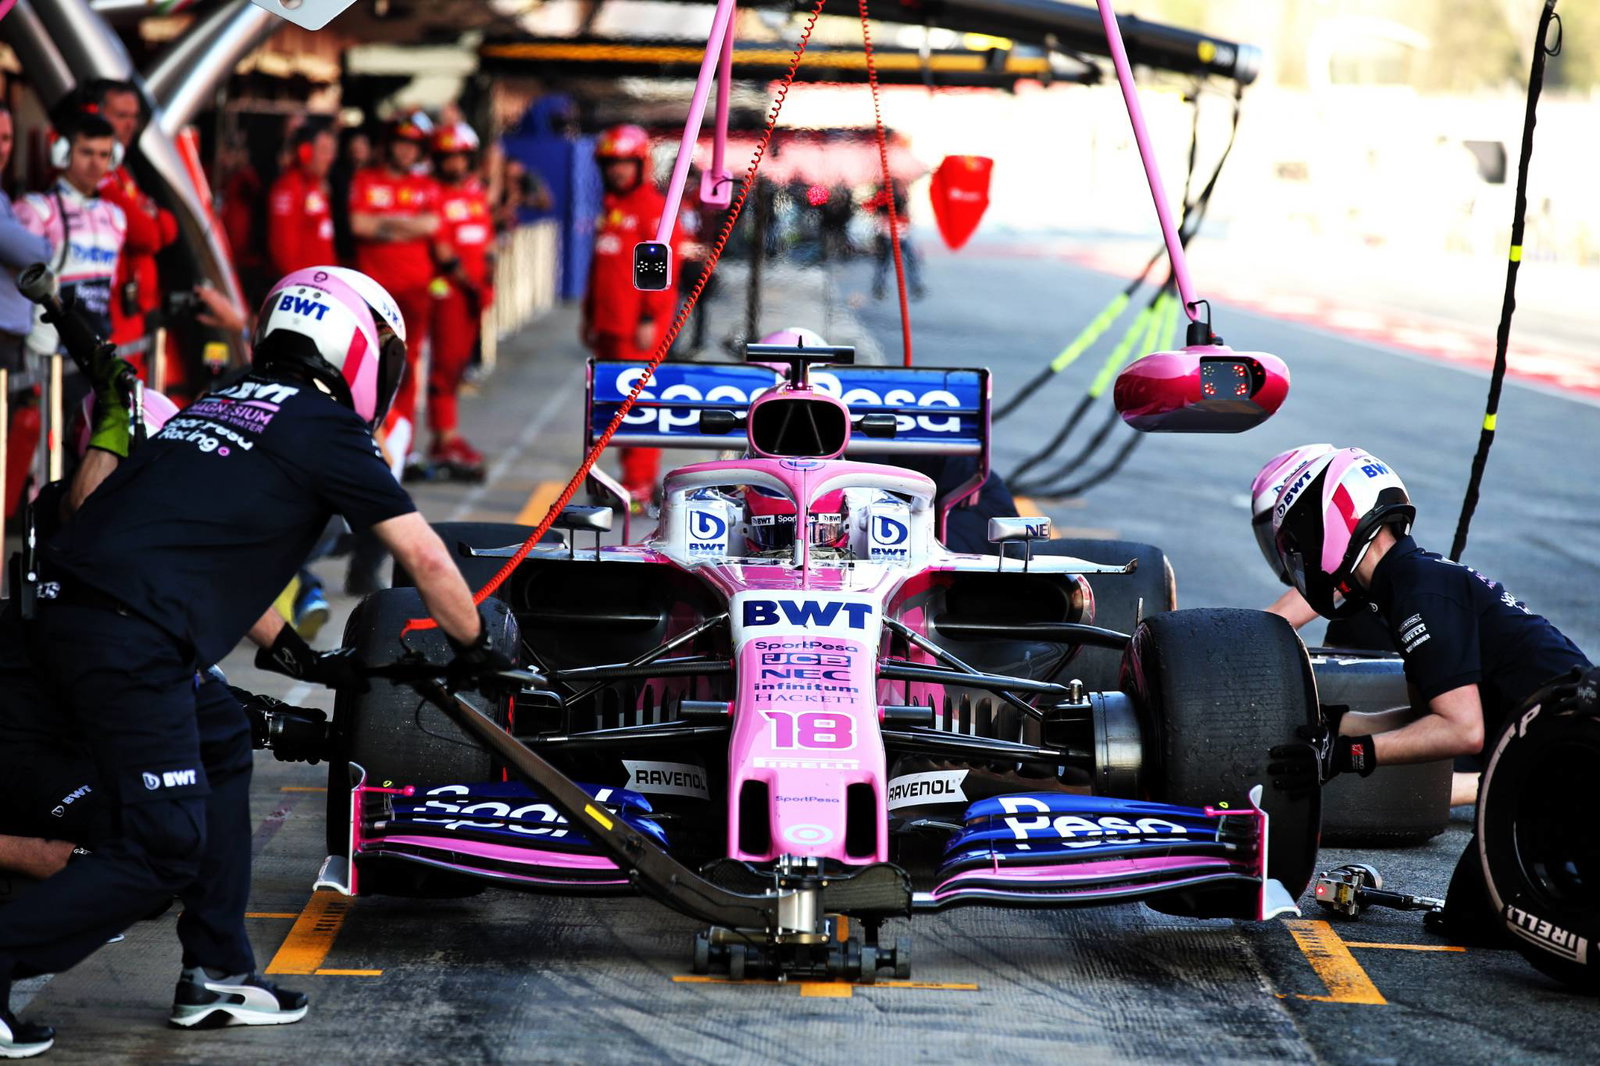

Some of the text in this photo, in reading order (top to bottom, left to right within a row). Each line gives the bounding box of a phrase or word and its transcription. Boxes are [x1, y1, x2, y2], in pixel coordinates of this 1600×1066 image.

[278, 295, 330, 321] BWT
[1284, 471, 1312, 506] BWT
[756, 517, 772, 525] BWT
[689, 543, 724, 551] BWT
[871, 547, 906, 556] BWT
[743, 600, 873, 630] BWT
[754, 641, 858, 653] SportPesa
[763, 653, 850, 667] JCB
[761, 669, 851, 681] NEC
[754, 682, 859, 693] infinitum
[755, 694, 859, 704] HACKETT
[758, 710, 857, 750] 18
[752, 757, 860, 770] PIRELLI
[163, 769, 196, 788] BWT
[636, 769, 706, 791] RAVENOL
[62, 784, 92, 805] BWT
[887, 776, 955, 801] RAVENOL
[775, 796, 840, 804] SportPesa
